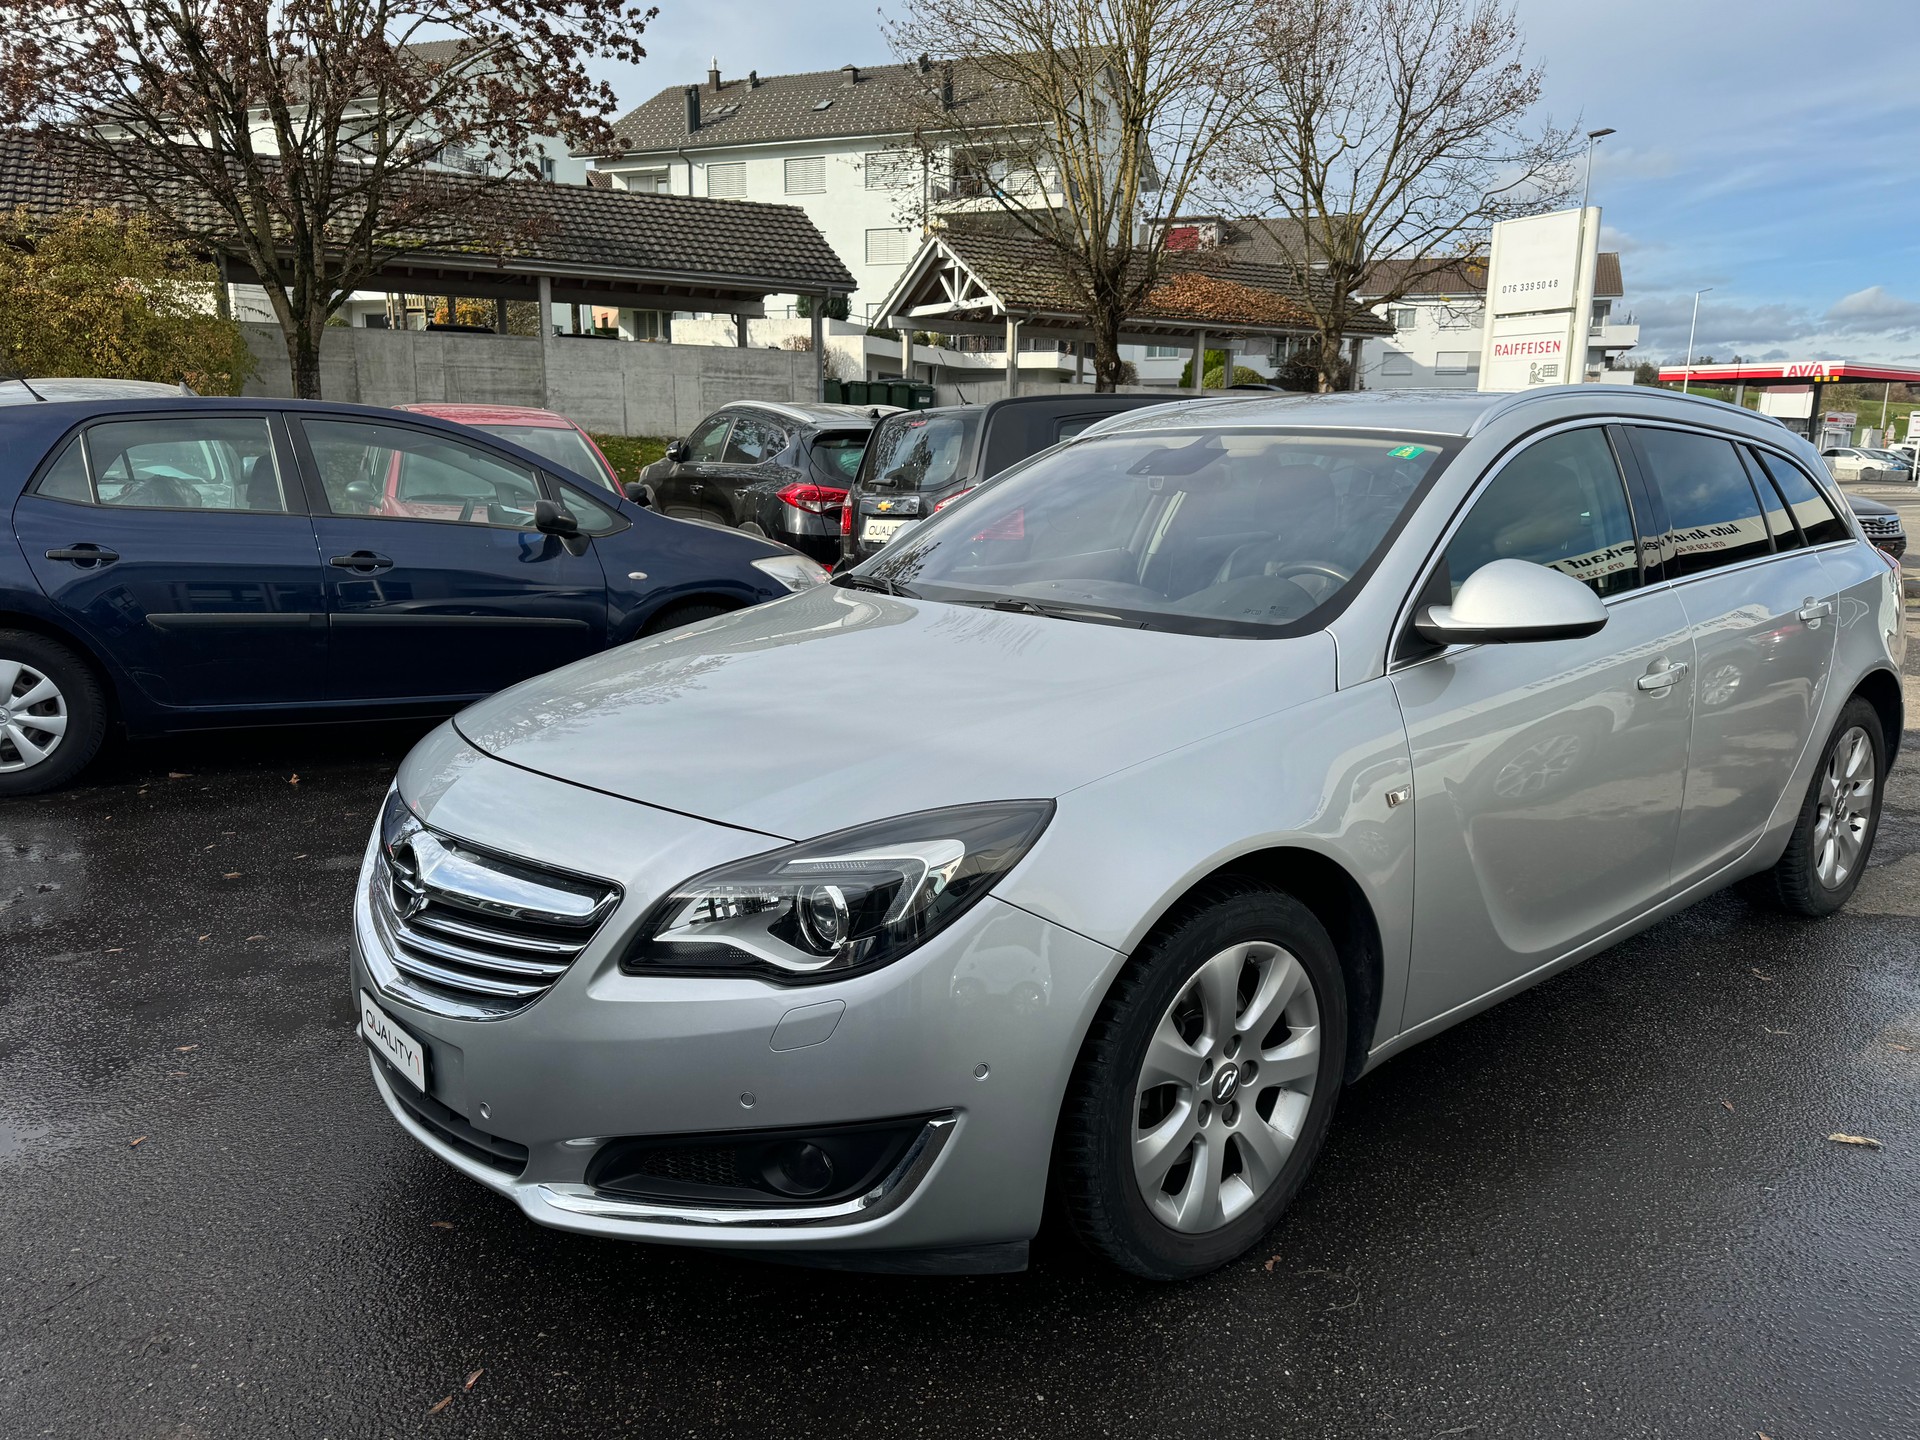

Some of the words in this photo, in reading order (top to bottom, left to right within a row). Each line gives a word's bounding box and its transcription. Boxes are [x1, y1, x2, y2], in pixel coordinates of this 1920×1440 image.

[1502, 284, 1517, 294] 076
[1494, 340, 1561, 356] RAIFFEISEN
[1788, 361, 1824, 377] AVIA
